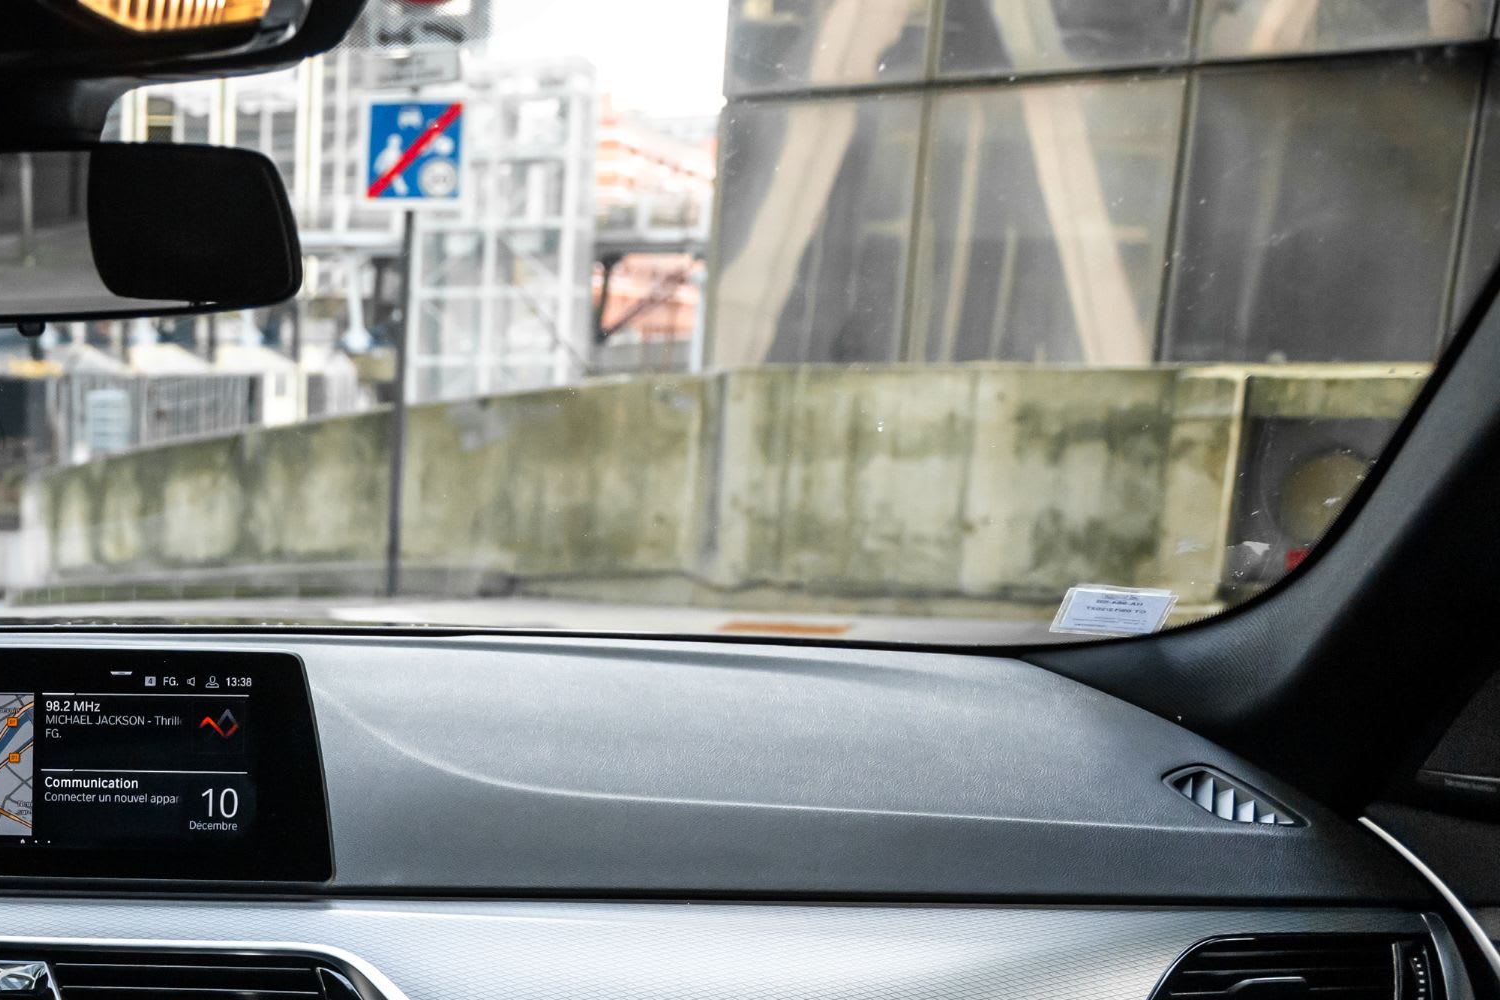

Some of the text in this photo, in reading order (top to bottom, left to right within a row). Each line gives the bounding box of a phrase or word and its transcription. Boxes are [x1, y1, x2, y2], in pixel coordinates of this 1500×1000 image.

[163, 677, 179, 687] FG.
[226, 677, 252, 687] 13:38
[45, 700, 100, 713] 98.2 MHz
[45, 714, 93, 725] MICHAEL
[95, 715, 146, 726] JACKSON
[45, 729, 62, 739] FG.
[44, 776, 139, 789] Communication
[44, 791, 180, 806] Connecter un nouvel appar
[200, 787, 239, 819] 10
[189, 819, 238, 831] Décembre
